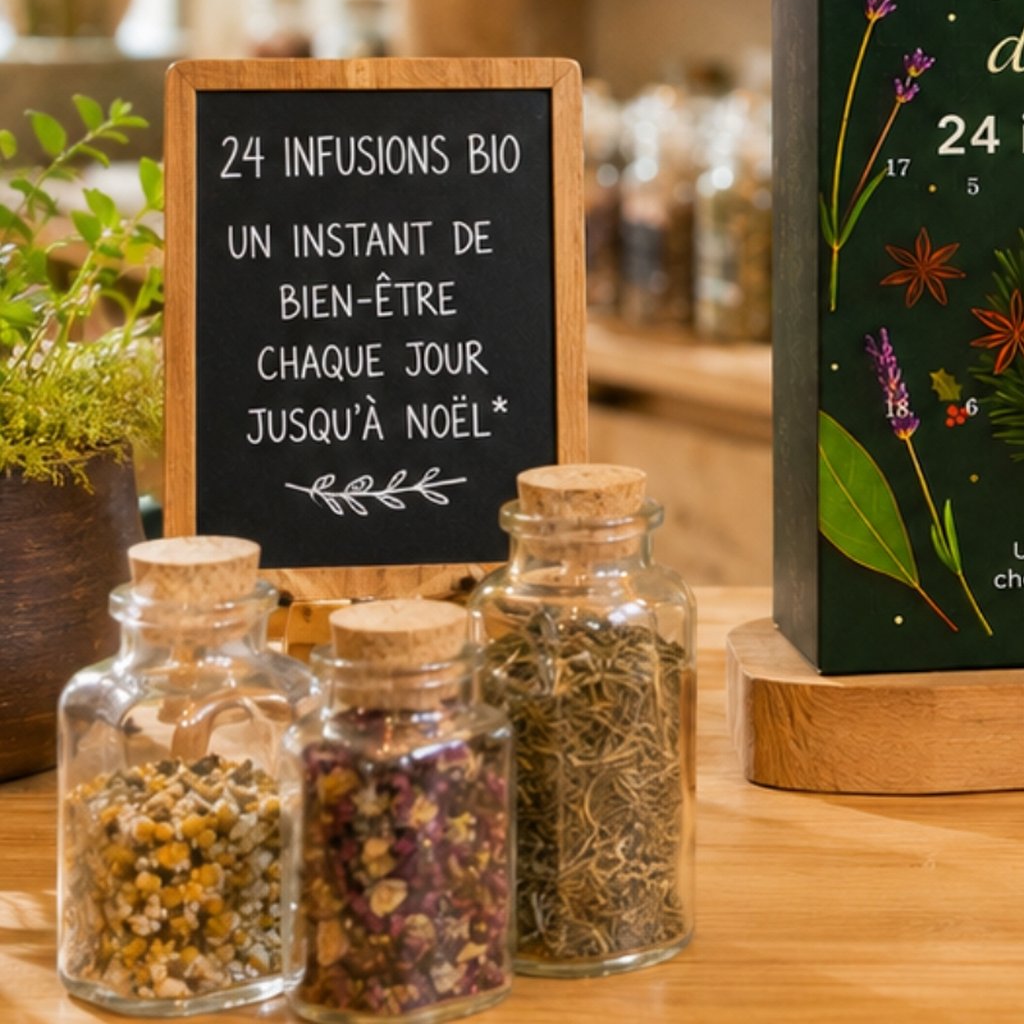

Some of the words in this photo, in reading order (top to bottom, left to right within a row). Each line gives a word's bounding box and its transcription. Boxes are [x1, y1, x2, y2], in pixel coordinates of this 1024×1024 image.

[937, 113, 1000, 155] 24
[220, 135, 265, 179] 24
[284, 134, 450, 178] INFUSIONS
[468, 134, 521, 175] BIO
[886, 158, 911, 177] 17
[967, 177, 980, 195] 5
[227, 224, 271, 259] UN
[293, 221, 432, 258] INSTANT
[453, 220, 493, 256] DE
[279, 271, 457, 320] BIEN-ÊTRE
[257, 343, 384, 382] CHAQUE
[405, 340, 489, 376] JOUR
[246, 394, 384, 445] JUSQU'À
[965, 397, 978, 416] 6
